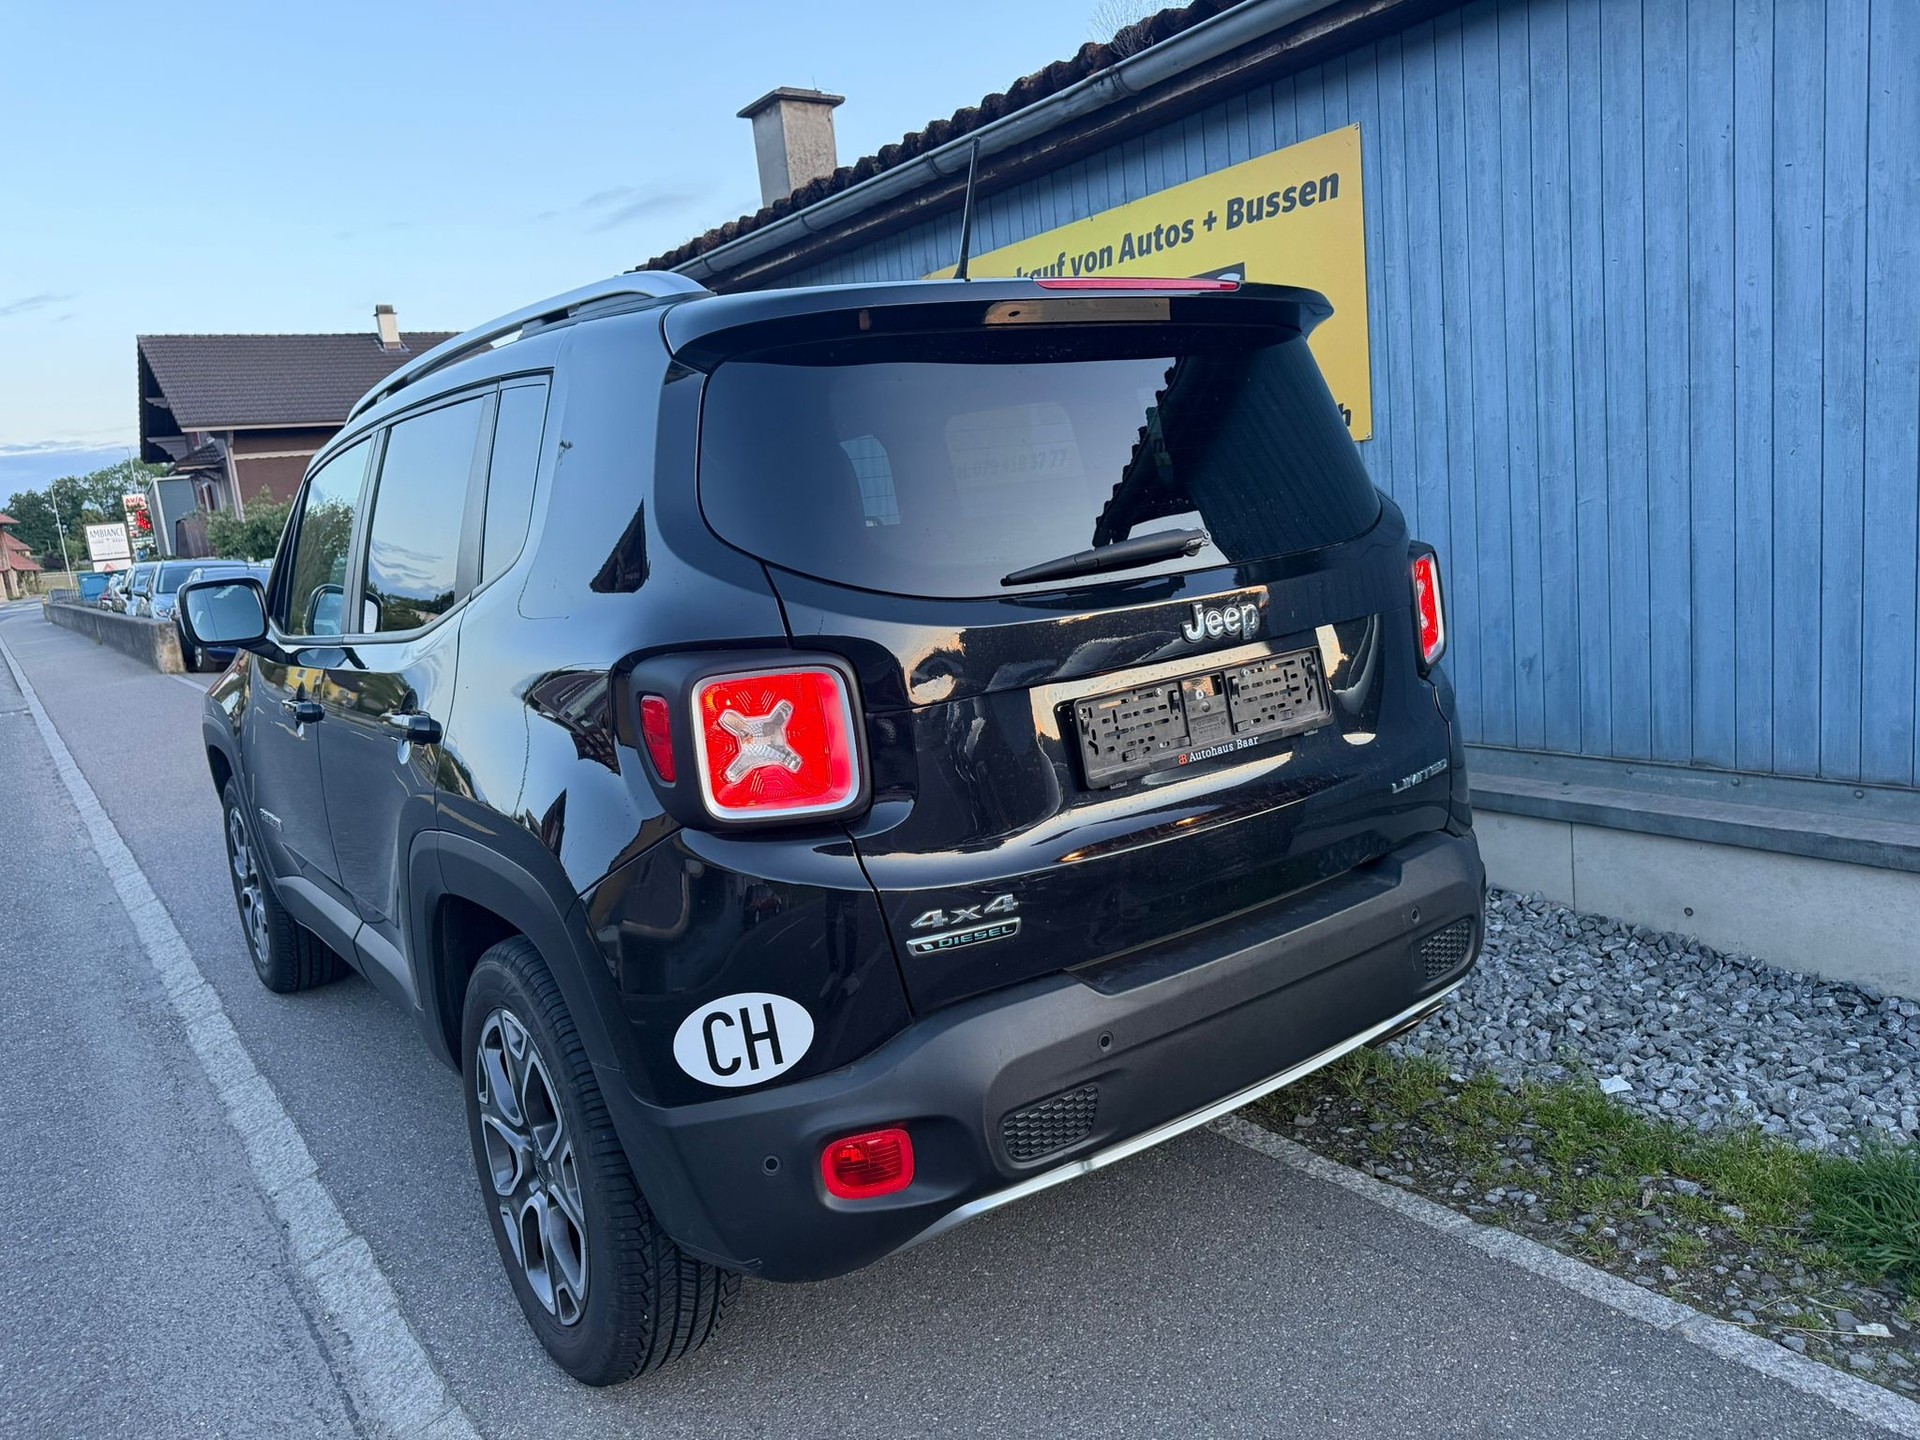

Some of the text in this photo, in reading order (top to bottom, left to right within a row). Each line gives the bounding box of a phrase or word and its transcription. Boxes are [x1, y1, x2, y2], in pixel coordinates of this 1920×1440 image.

[1070, 245, 1113, 277] von
[1118, 218, 1194, 264] Autos
[1203, 210, 1217, 232] +
[1226, 172, 1339, 230] Bussen
[125, 496, 144, 504] AVIA
[89, 527, 124, 538] AMBIANCE
[1181, 603, 1260, 641] Jeep
[1189, 743, 1234, 762] Autohaus
[1236, 736, 1259, 750] Baar
[911, 894, 1019, 928] 4x4
[938, 926, 1013, 948] DIESEL
[702, 1002, 784, 1077] CH
